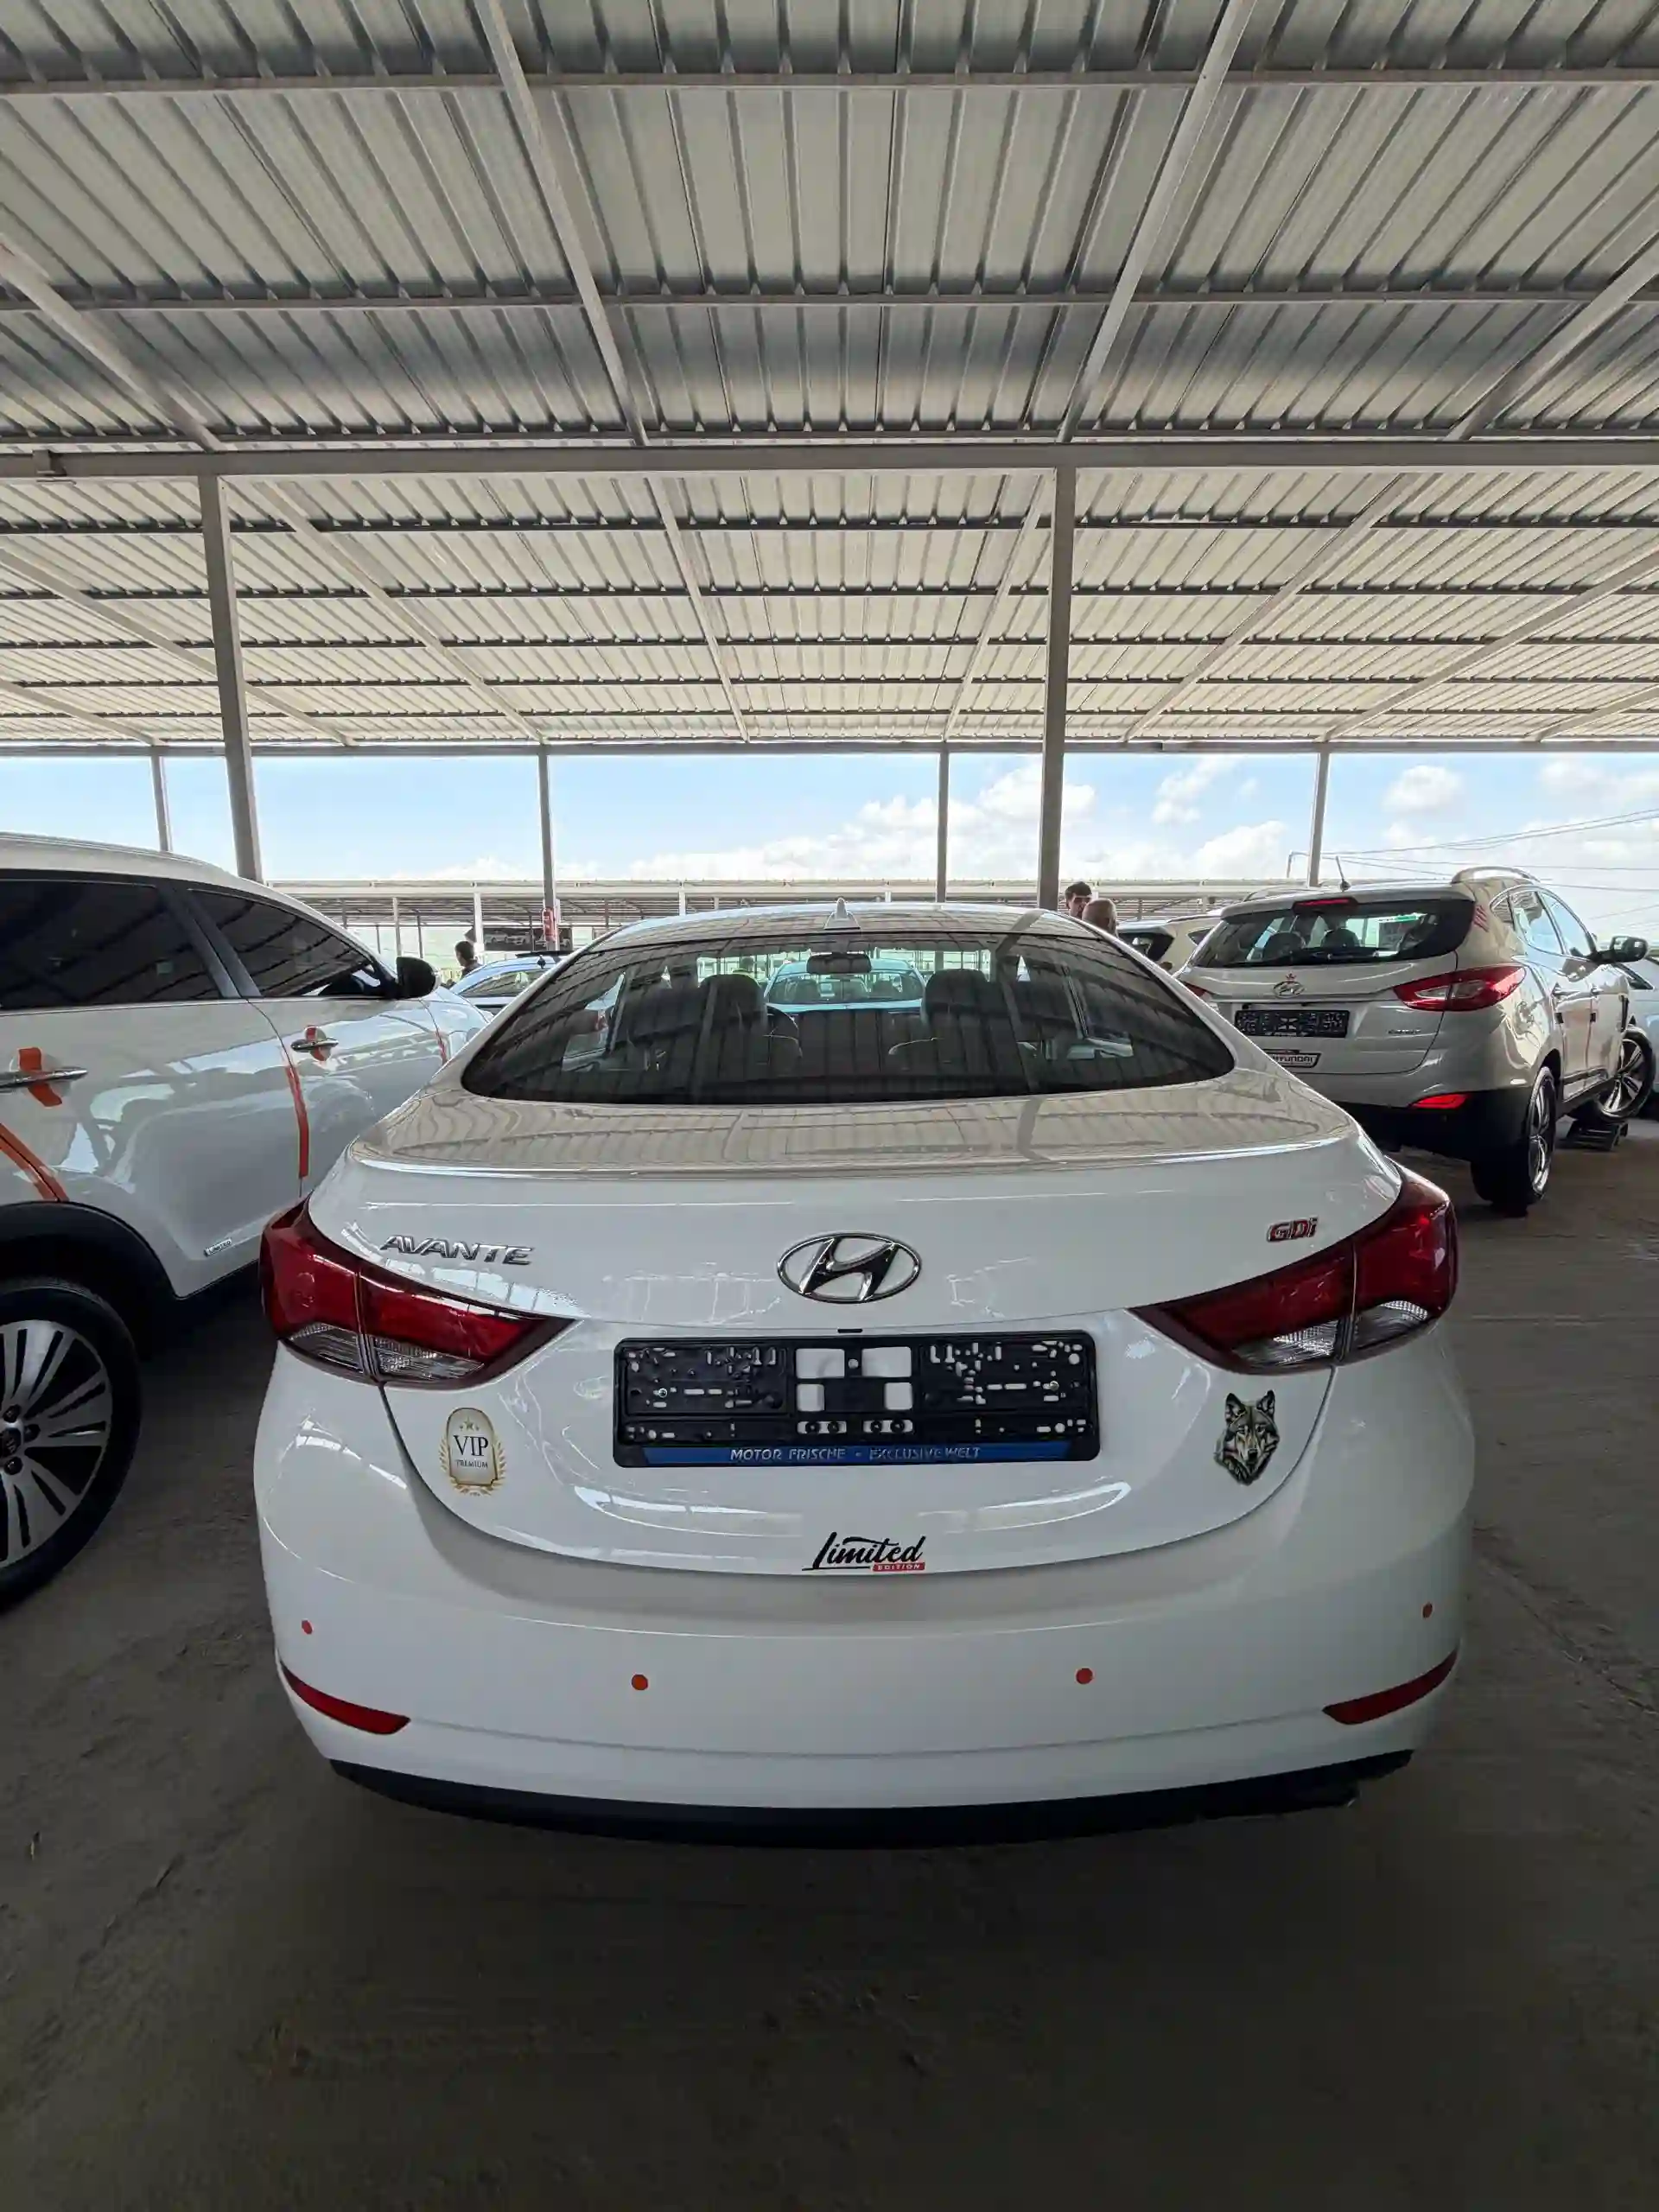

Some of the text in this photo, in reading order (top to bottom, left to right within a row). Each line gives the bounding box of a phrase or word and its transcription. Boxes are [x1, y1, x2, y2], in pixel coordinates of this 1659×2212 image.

[379, 1234, 535, 1266] AVANTE
[453, 1435, 489, 1457] VIP
[730, 1448, 782, 1460] MOTOR
[788, 1448, 846, 1460] FRISCHE
[869, 1447, 942, 1460] EXCLUSIVE
[944, 1446, 981, 1459] WELT
[455, 1459, 488, 1468] PREMIUM
[812, 1532, 926, 1569] Limited
